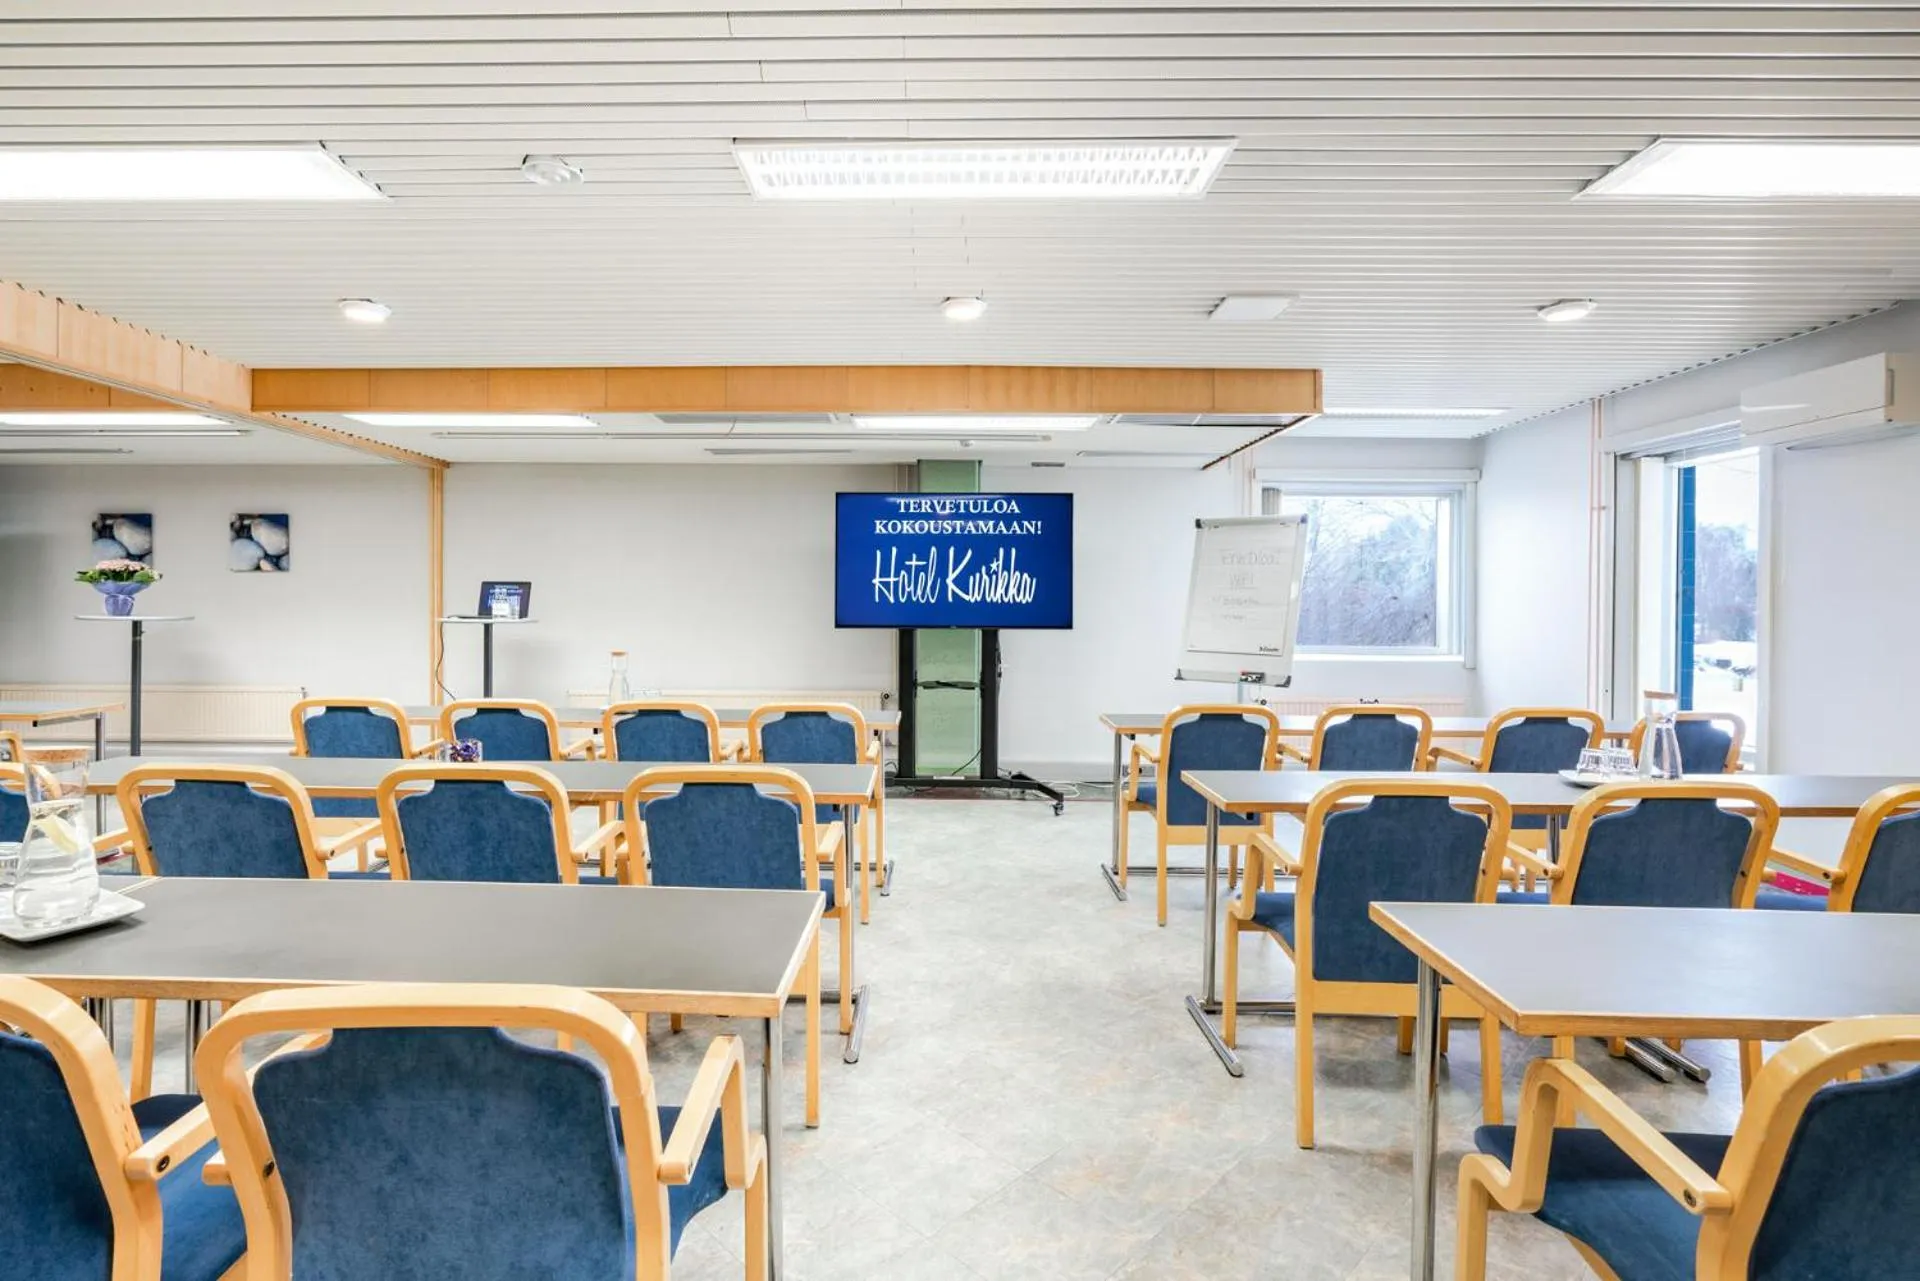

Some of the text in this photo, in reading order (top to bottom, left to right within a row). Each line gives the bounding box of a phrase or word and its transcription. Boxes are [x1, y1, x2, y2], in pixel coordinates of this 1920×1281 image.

[898, 499, 1020, 514] TERVETULOA
[874, 520, 1042, 535] KOKOUSTAMAAN!
[872, 546, 1037, 604] Hotel Kurikka
